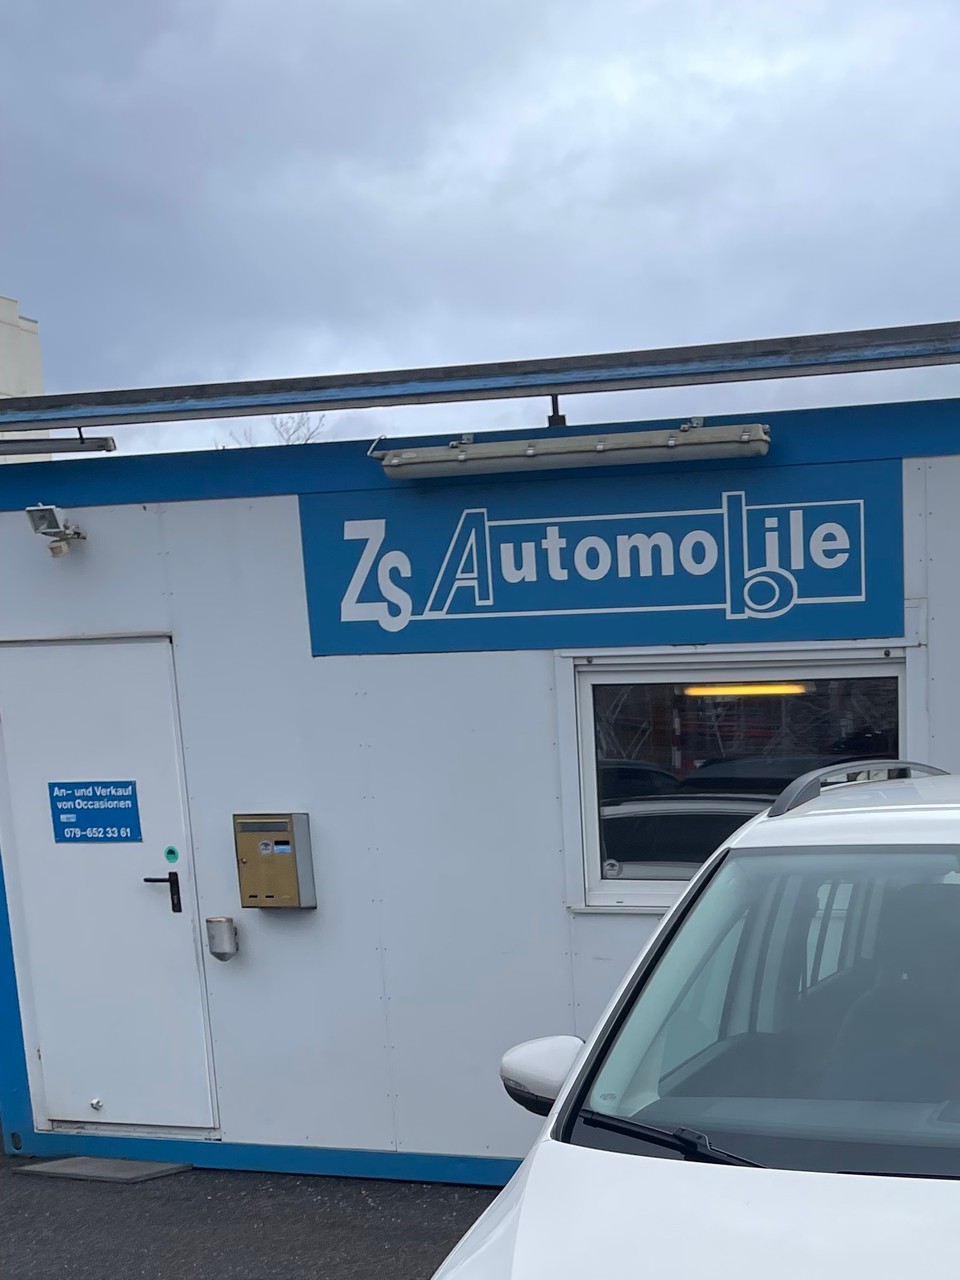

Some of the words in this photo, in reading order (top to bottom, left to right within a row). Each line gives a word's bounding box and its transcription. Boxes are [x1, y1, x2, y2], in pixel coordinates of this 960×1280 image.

[421, 491, 851, 620] Automobile
[53, 786, 73, 797] An-
[74, 785, 93, 797] und
[94, 785, 133, 797] Verkauf
[56, 800, 75, 810] von
[75, 798, 132, 809] Occasionen
[64, 826, 105, 838] 079-652
[106, 827, 119, 838] 33
[120, 827, 131, 838] 61
